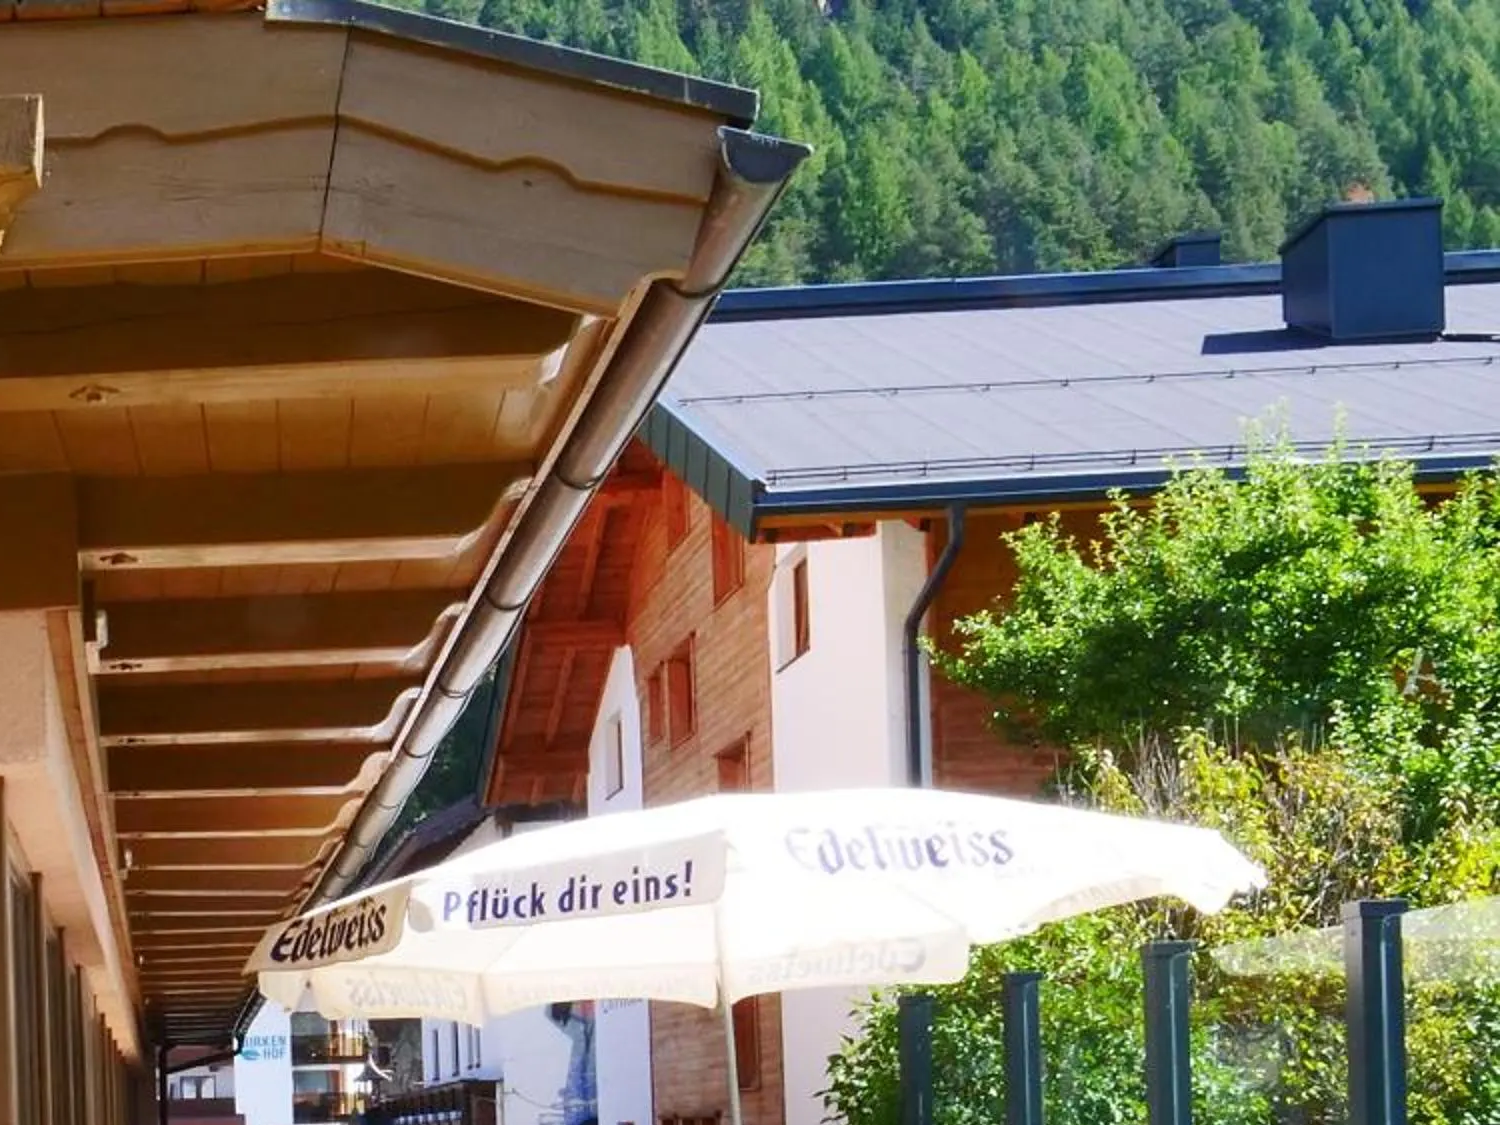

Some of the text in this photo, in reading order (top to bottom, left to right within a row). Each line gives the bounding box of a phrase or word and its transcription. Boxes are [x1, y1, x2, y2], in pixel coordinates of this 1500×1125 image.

[783, 822, 1015, 876] Edelweiss
[442, 859, 694, 924] Pflück dir eins!
[269, 902, 388, 963] Edelweiss
